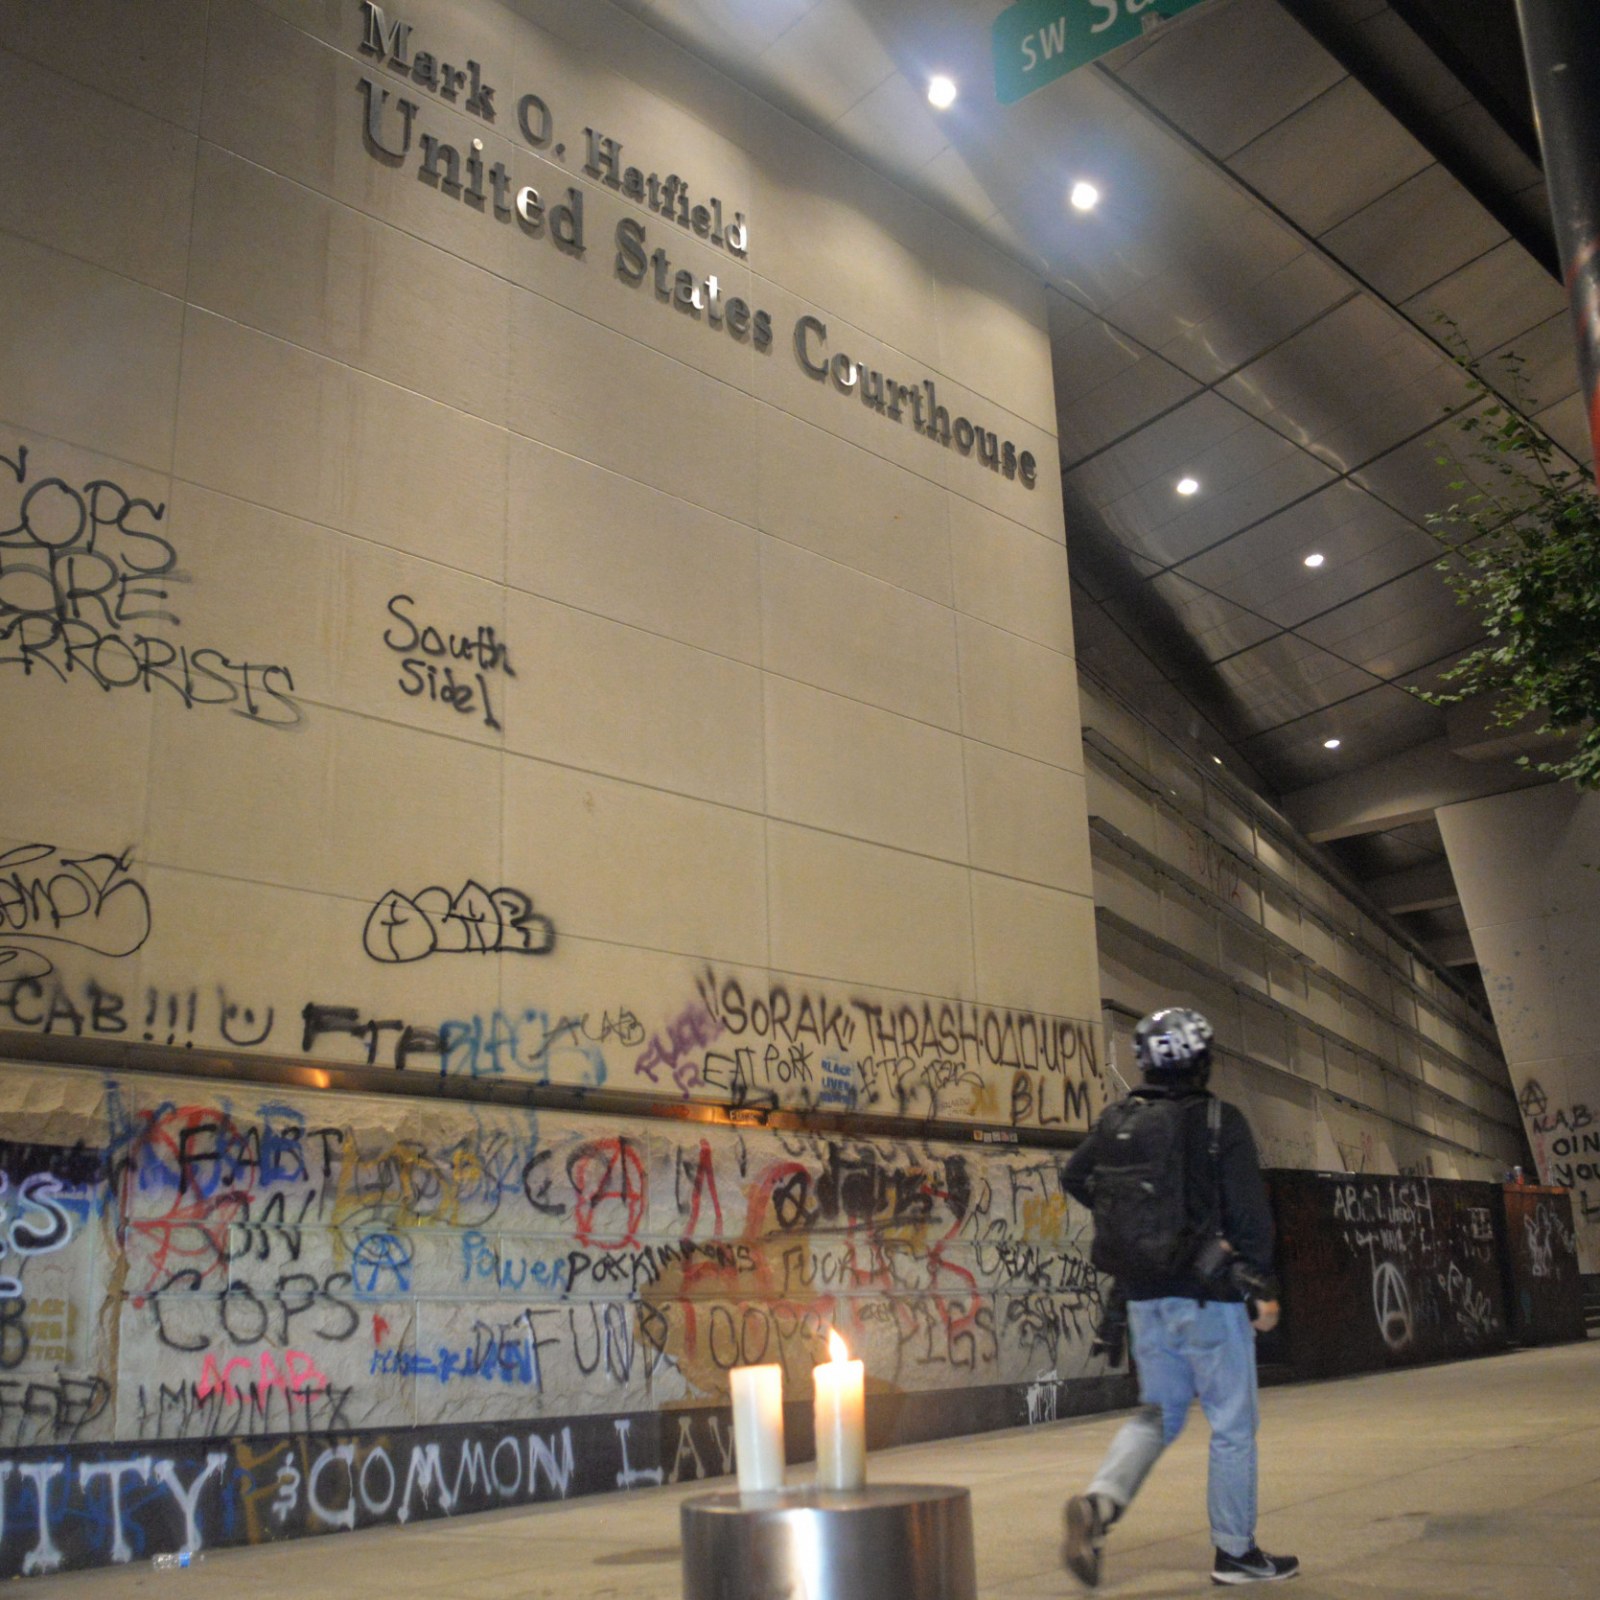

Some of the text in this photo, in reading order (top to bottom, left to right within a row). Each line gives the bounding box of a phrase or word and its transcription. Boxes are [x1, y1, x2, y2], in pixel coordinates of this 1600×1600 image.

[1021, 17, 1066, 72] SW
[360, 1, 750, 260] Mark O. Hatfield
[358, 78, 1040, 490] United States Courthouse
[1011, 1072, 1092, 1131] BLM
[154, 1268, 360, 1352] COPS
[197, 1349, 328, 1408] ACAB
[307, 1426, 575, 1531] COMMON
